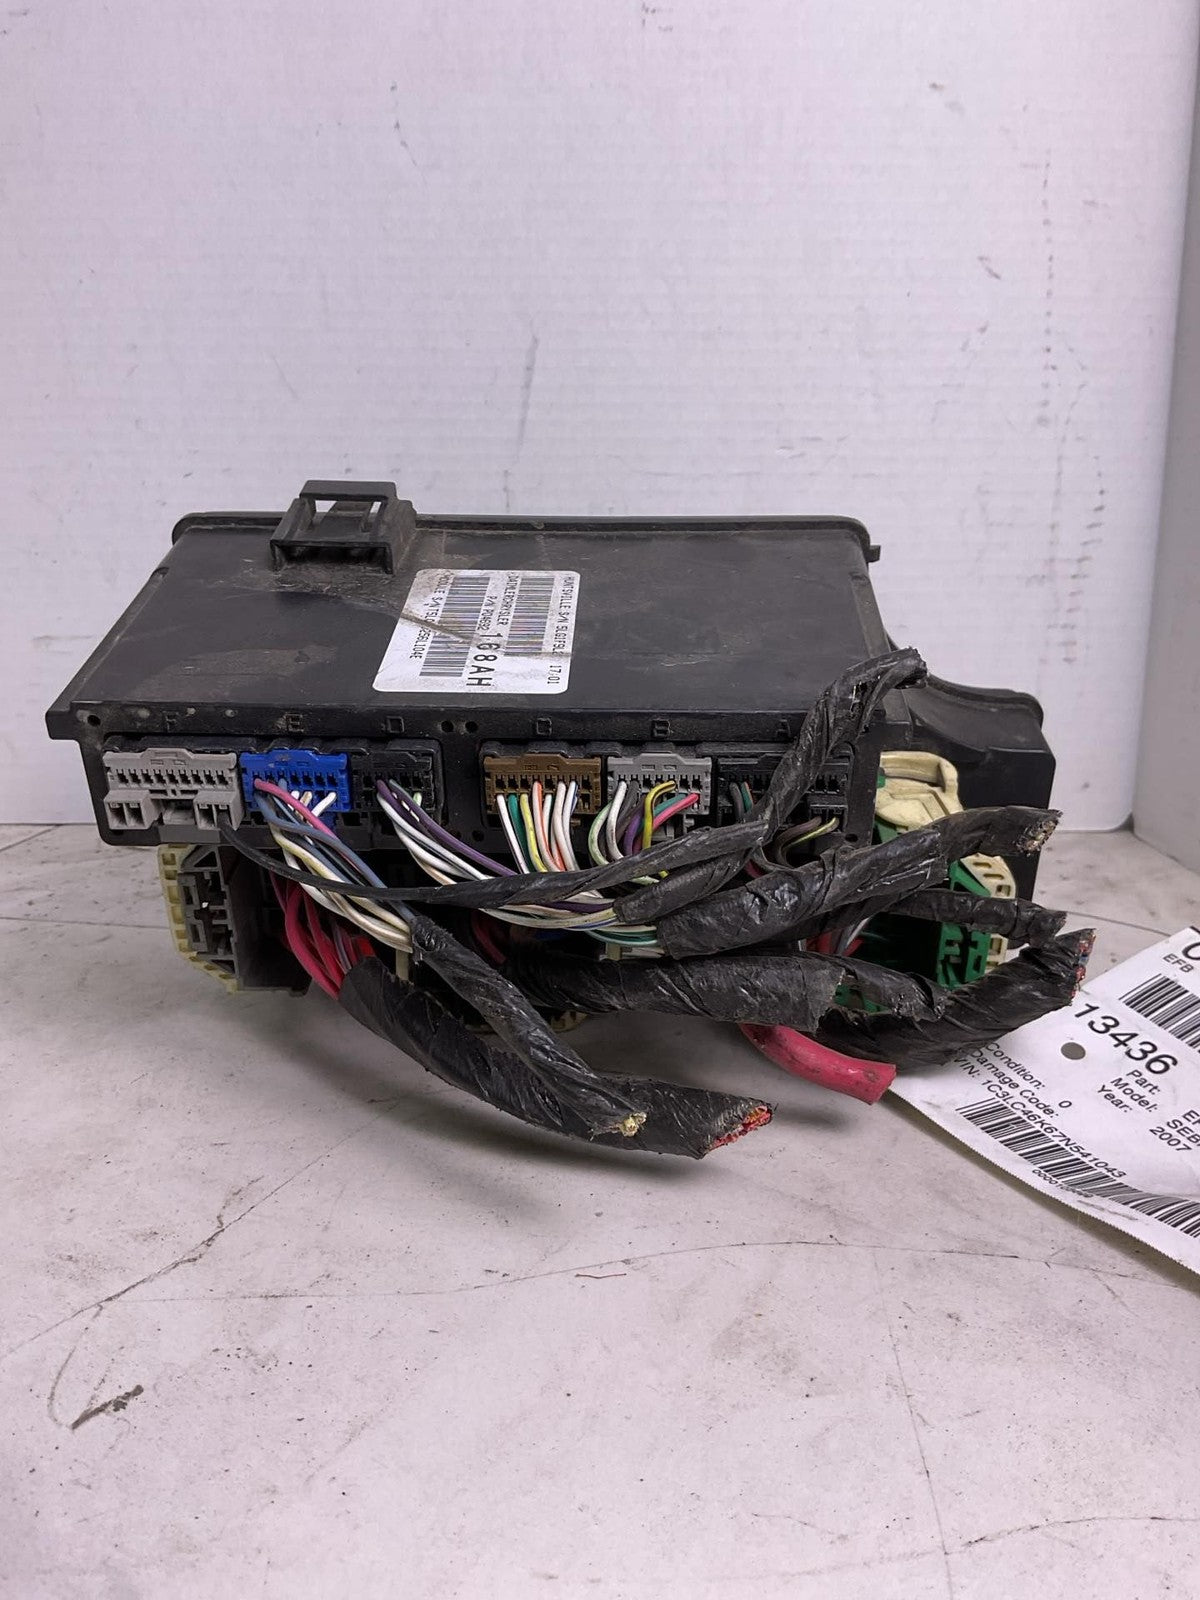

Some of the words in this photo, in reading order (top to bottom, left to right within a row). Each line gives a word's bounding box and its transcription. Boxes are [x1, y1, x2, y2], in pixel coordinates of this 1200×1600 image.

[1163, 953, 1194, 973] EFB
[986, 1042, 1046, 1090] Condition:
[1074, 1003, 1178, 1075] 13436
[954, 1058, 982, 1079] VIN:
[970, 1050, 1020, 1091] Damage
[1019, 1088, 1060, 1119] Code:
[1126, 1069, 1162, 1096] Part:
[1098, 1085, 1133, 1113] Year:
[1149, 1126, 1192, 1151] 2007
[1111, 1077, 1158, 1113] Model:
[1167, 1119, 1200, 1147] SEB
